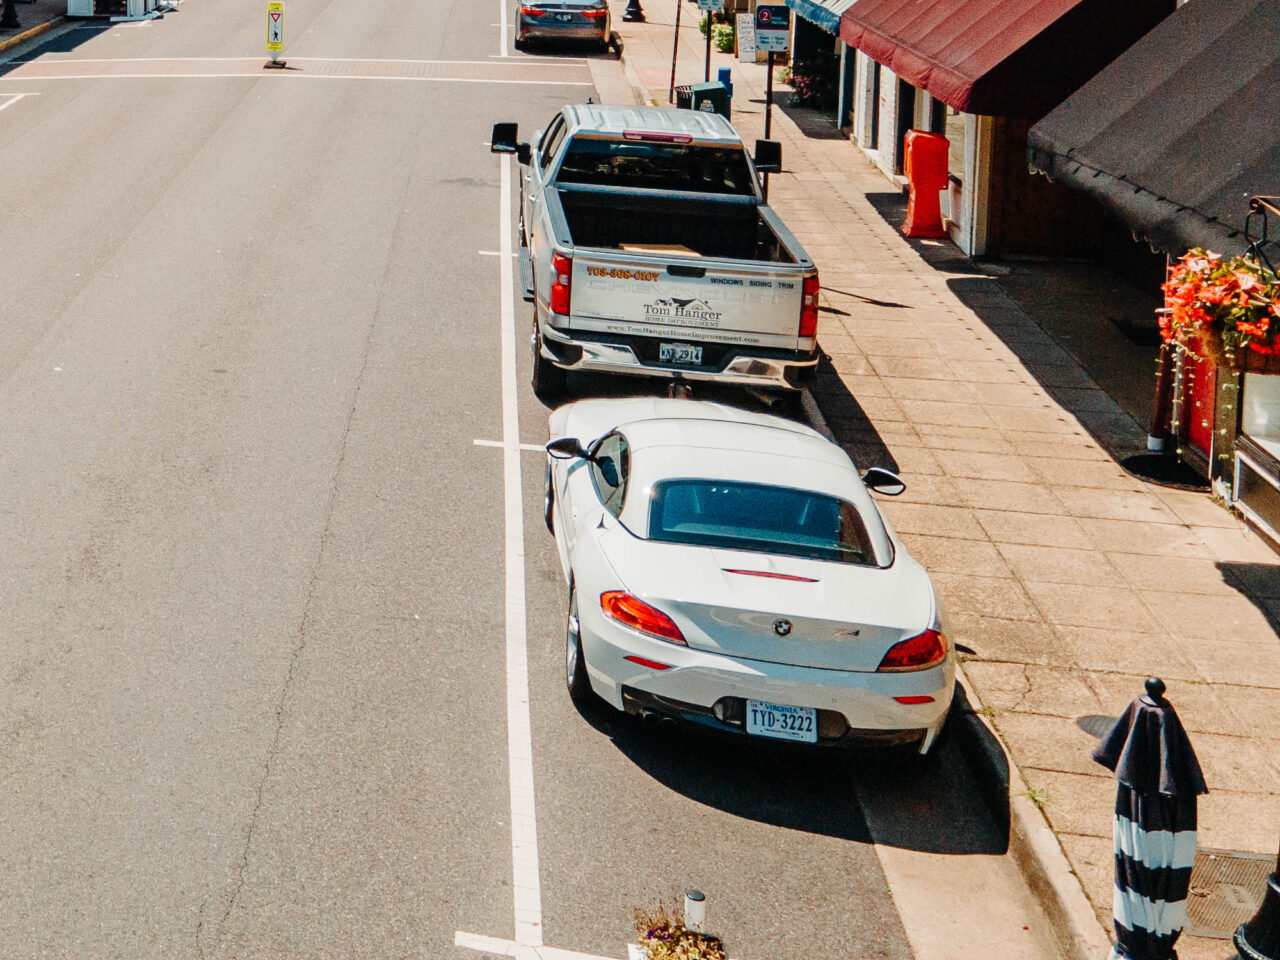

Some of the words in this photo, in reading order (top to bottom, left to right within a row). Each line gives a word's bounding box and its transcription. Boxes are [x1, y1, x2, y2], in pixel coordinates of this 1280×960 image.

[762, 11, 769, 21] 2
[710, 277, 744, 286] WINDOWS
[749, 280, 773, 288] SIDING
[643, 303, 670, 316] Tom
[675, 306, 722, 321] Hanger
[667, 317, 720, 328] IMPROVEMENT
[679, 349, 700, 361] 2914
[765, 704, 799, 715] VIRGINIA
[751, 709, 813, 733] TYD-3222
